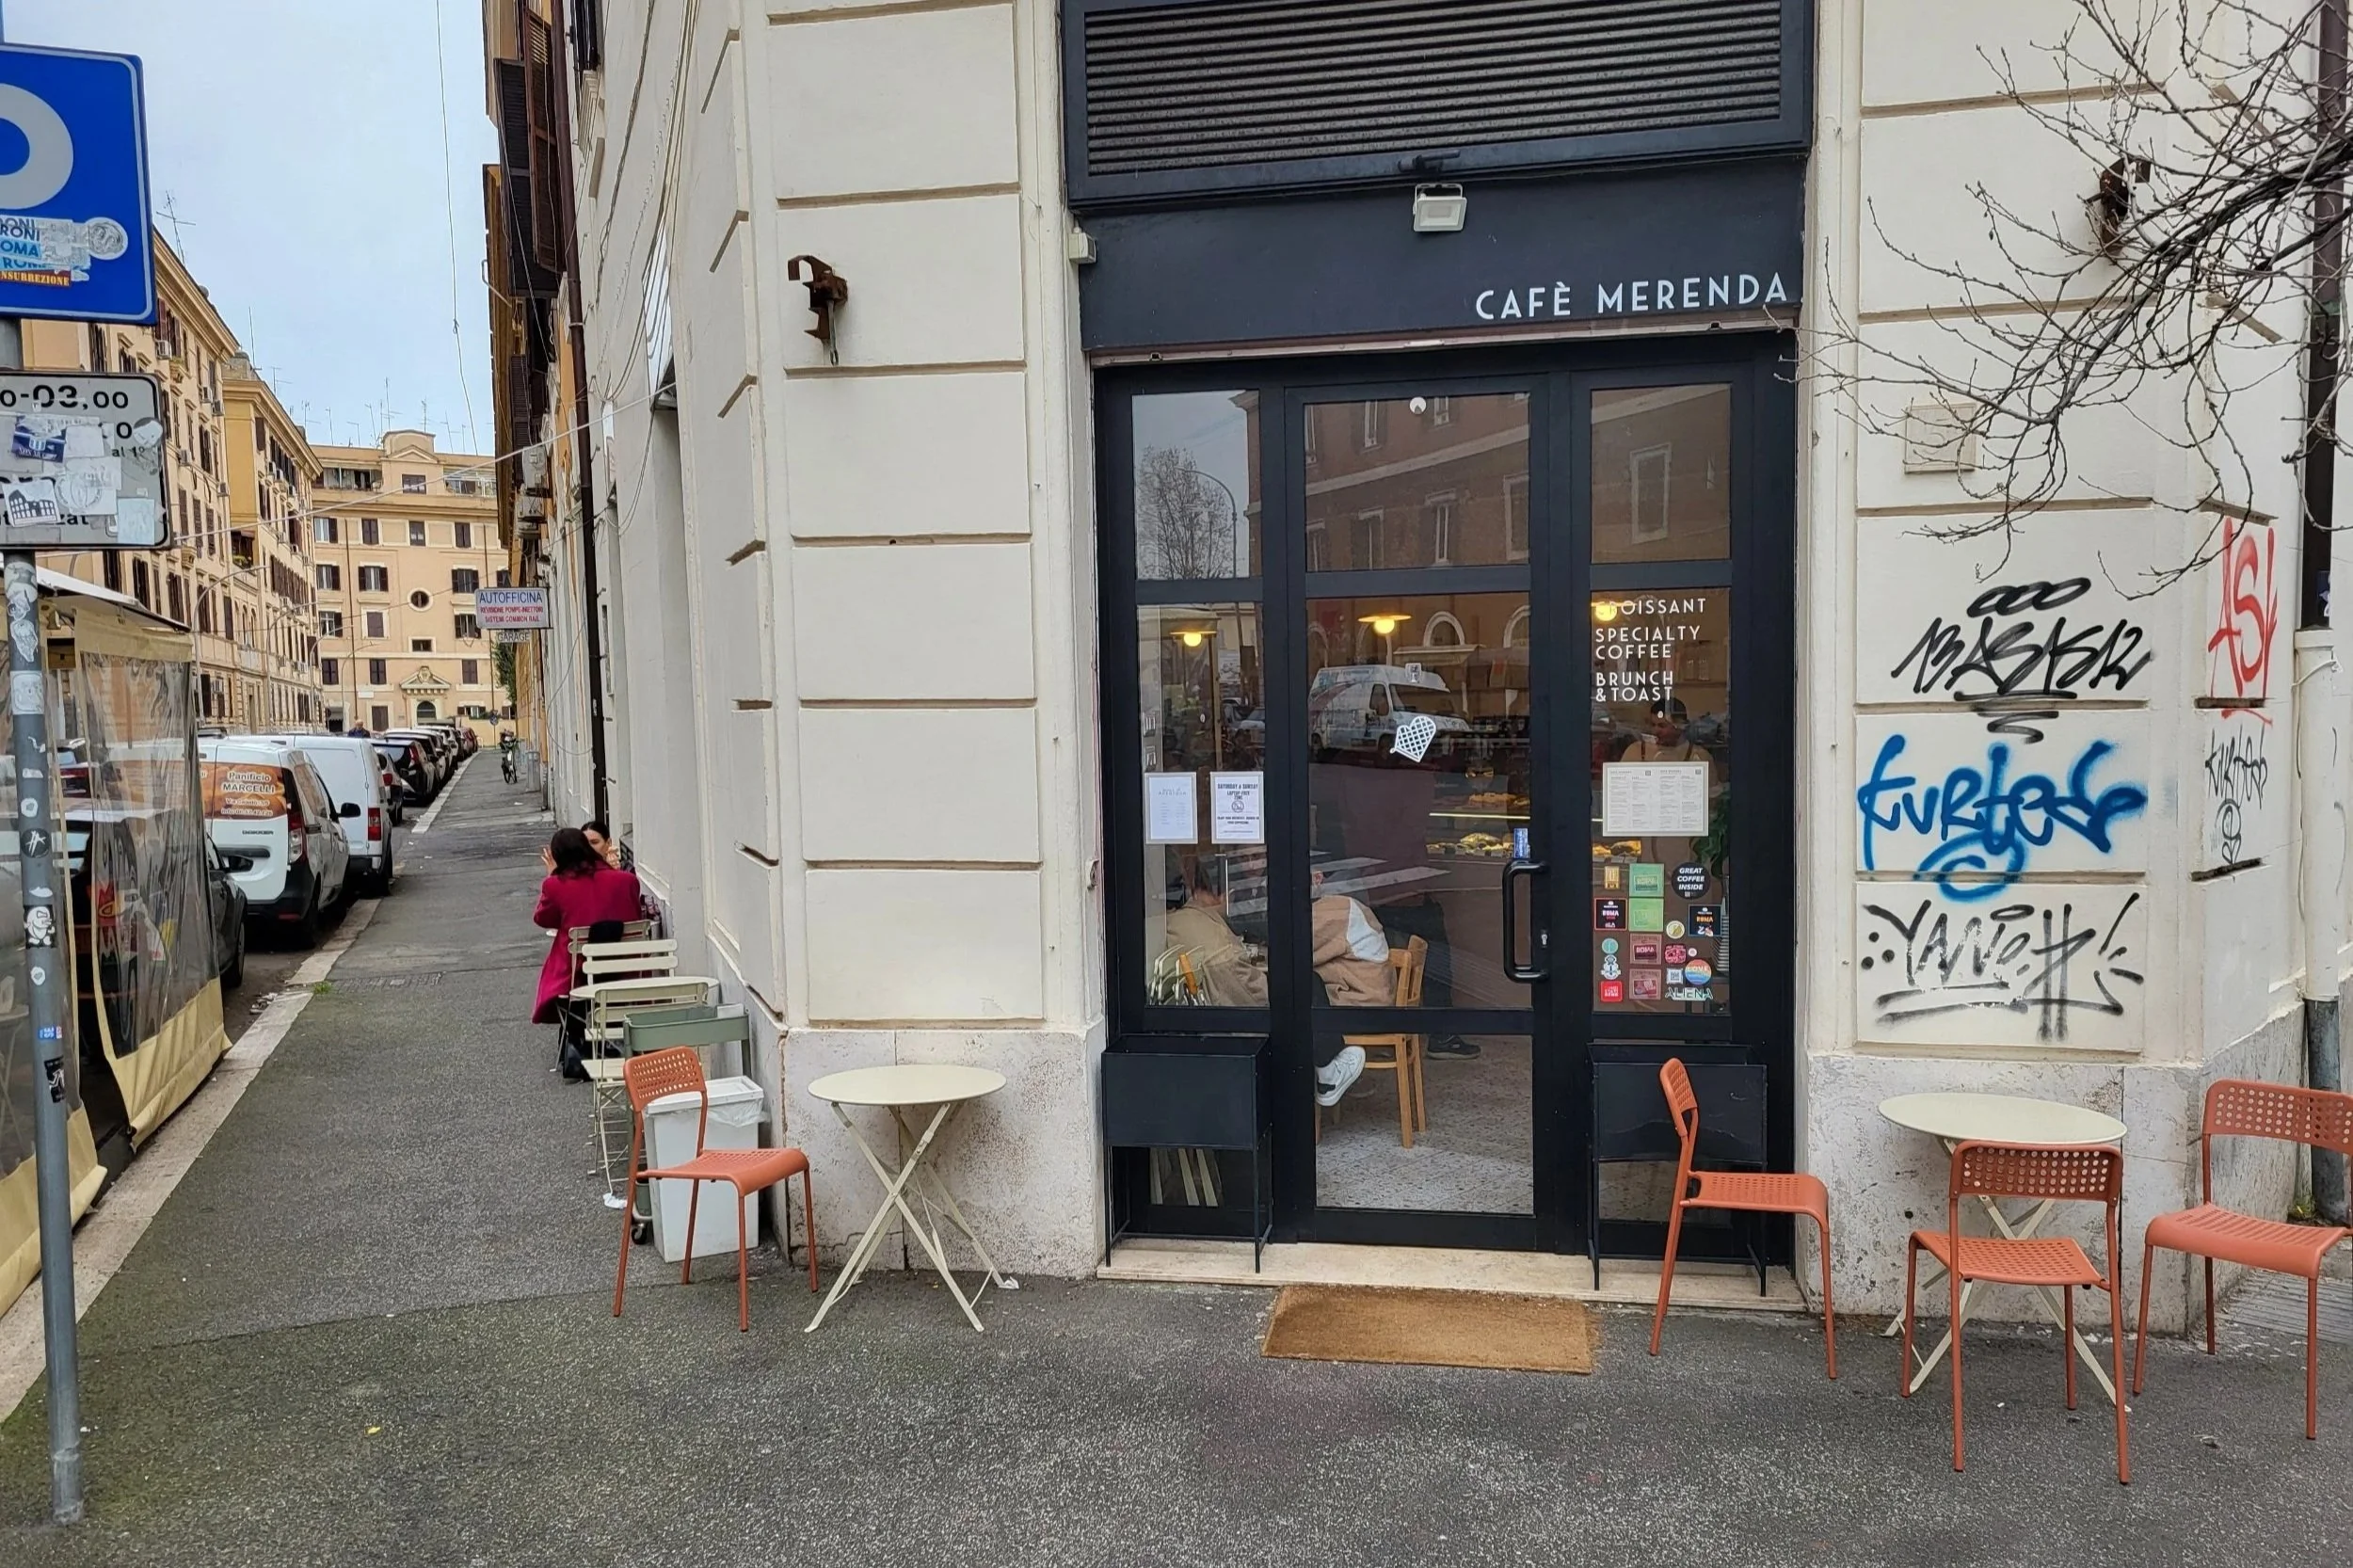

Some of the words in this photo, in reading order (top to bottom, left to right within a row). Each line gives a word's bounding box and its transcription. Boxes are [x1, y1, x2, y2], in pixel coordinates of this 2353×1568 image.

[1475, 281, 1571, 320] CAFÈ
[1597, 272, 1787, 313] MERENDA
[479, 591, 543, 603] AUTOFFICINA
[497, 632, 530, 641] GARAGE
[1595, 625, 1701, 642] SPECIALTY
[1595, 644, 1672, 660] COFFEE
[1595, 670, 1673, 686] BRUNCH
[229, 772, 271, 781] Panificio
[222, 783, 275, 792] MARCELLI
[1665, 986, 1713, 1000] ALIENA
